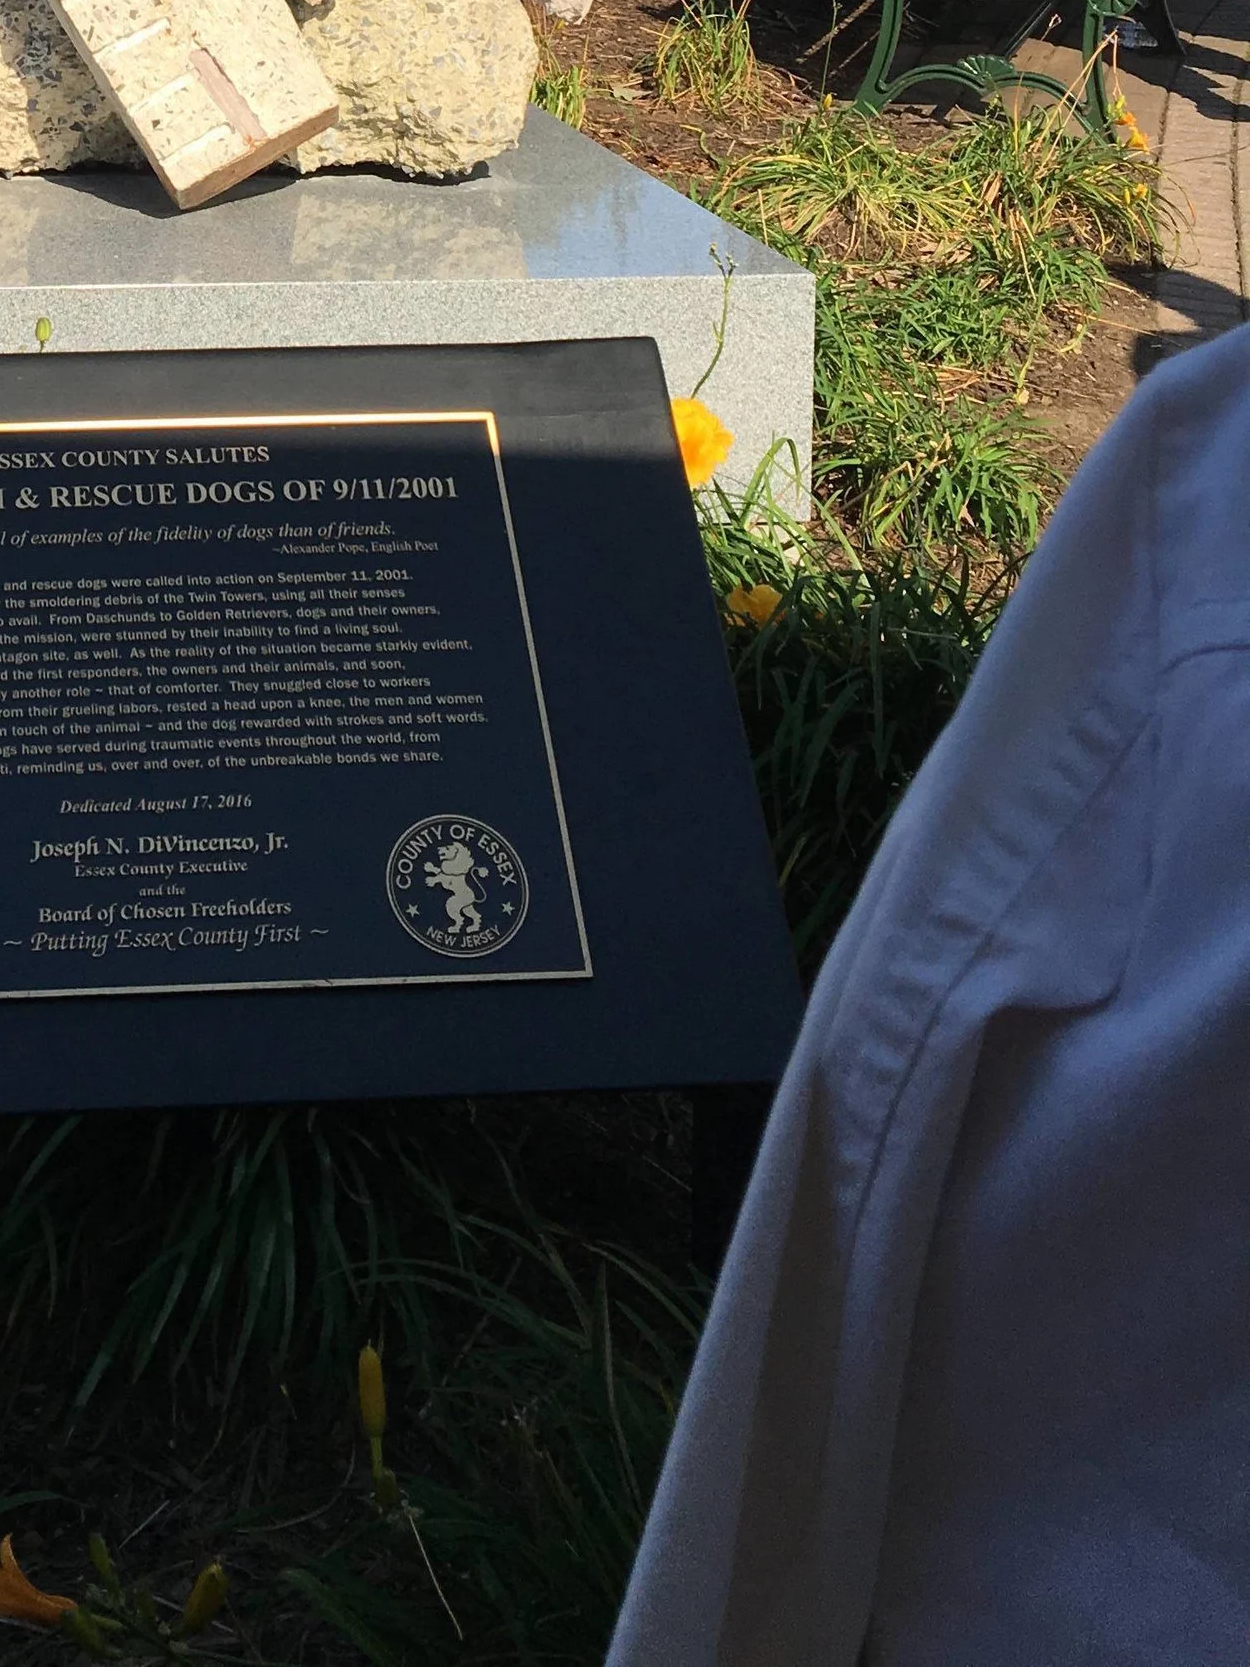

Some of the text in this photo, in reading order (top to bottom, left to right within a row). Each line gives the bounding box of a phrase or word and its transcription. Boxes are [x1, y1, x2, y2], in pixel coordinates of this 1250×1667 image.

[61, 449, 159, 467] COUNTY
[166, 446, 270, 464] SALUTES
[15, 487, 40, 509] &
[50, 483, 177, 507] RESCUE
[186, 480, 275, 504] DOGS
[283, 479, 326, 501] OF
[333, 477, 457, 500] 9/11/2001
[10, 530, 30, 548] of
[30, 528, 103, 547] examples
[108, 527, 127, 545] of
[128, 527, 152, 541] the
[153, 525, 213, 545] fidelity
[217, 524, 236, 542] of
[237, 524, 274, 542] dogs
[278, 523, 312, 537] than
[317, 522, 336, 540] of
[335, 521, 395, 540] friends.
[4, 580, 27, 591] and
[32, 580, 73, 590] rescue
[77, 578, 107, 590] dogs
[111, 578, 141, 587] were
[146, 575, 183, 587] called
[187, 575, 211, 585] into
[216, 573, 254, 585] action
[258, 575, 274, 584] on
[277, 571, 346, 585] September
[351, 570, 372, 582] 11,
[375, 569, 413, 581] 2001.
[5, 597, 25, 609] the
[30, 595, 101, 608] smoldering
[104, 593, 143, 605] debris
[147, 593, 159, 605] of
[164, 593, 184, 604] the
[188, 592, 216, 603] Twin
[220, 591, 267, 602] Towers,
[272, 589, 306, 602] using
[310, 589, 325, 600] all
[329, 588, 358, 599] their
[361, 589, 405, 598] senses
[0, 633, 19, 645] the
[24, 633, 77, 644] mission,
[81, 632, 111, 642] were
[116, 629, 167, 641] stunned
[172, 628, 186, 641] by
[190, 627, 219, 638] their
[223, 626, 274, 639] inability
[278, 626, 290, 636] to
[294, 624, 319, 636] find
[323, 626, 331, 635] a
[335, 623, 369, 636] living
[372, 622, 402, 633] soul.
[28, 705, 58, 717] their
[62, 703, 115, 718] grueling
[119, 702, 162, 714] labors,
[167, 700, 207, 712] rested
[212, 702, 220, 711] a
[224, 698, 256, 710] head
[261, 700, 293, 711] upon
[297, 699, 305, 708] a
[309, 697, 345, 708] knee,
[349, 696, 370, 707] the
[374, 696, 403, 706] men
[408, 694, 432, 705] and
[436, 694, 483, 704] women
[22, 743, 52, 755] have
[57, 741, 100, 753] served
[105, 740, 147, 753] during
[151, 738, 214, 751] traumatic
[218, 736, 261, 748] events
[265, 734, 337, 748] throughout
[341, 733, 362, 745] the
[366, 732, 405, 744] world,
[409, 731, 440, 742] from
[17, 761, 84, 774] reminding
[88, 762, 107, 772] us,
[111, 761, 139, 771] over
[144, 758, 168, 770] and
[173, 759, 203, 769] over,
[208, 755, 220, 768] of
[225, 755, 246, 767] the
[251, 753, 332, 766] unbreakable
[337, 752, 377, 764] bonds
[380, 753, 399, 762] we
[403, 751, 443, 762] share.
[60, 794, 252, 813] Dedicated August 17, 2016
[30, 832, 288, 863] Joseph N. DiVincenzo, Jr.
[396, 824, 516, 888] COUNTY OF ESSEX
[74, 859, 248, 879] Essex County Executive
[139, 883, 185, 896] and the
[39, 898, 292, 925] Board of Chosen Freeholders
[31, 924, 300, 957] Putting Essex County First
[426, 925, 500, 948] NEW JERSEY
